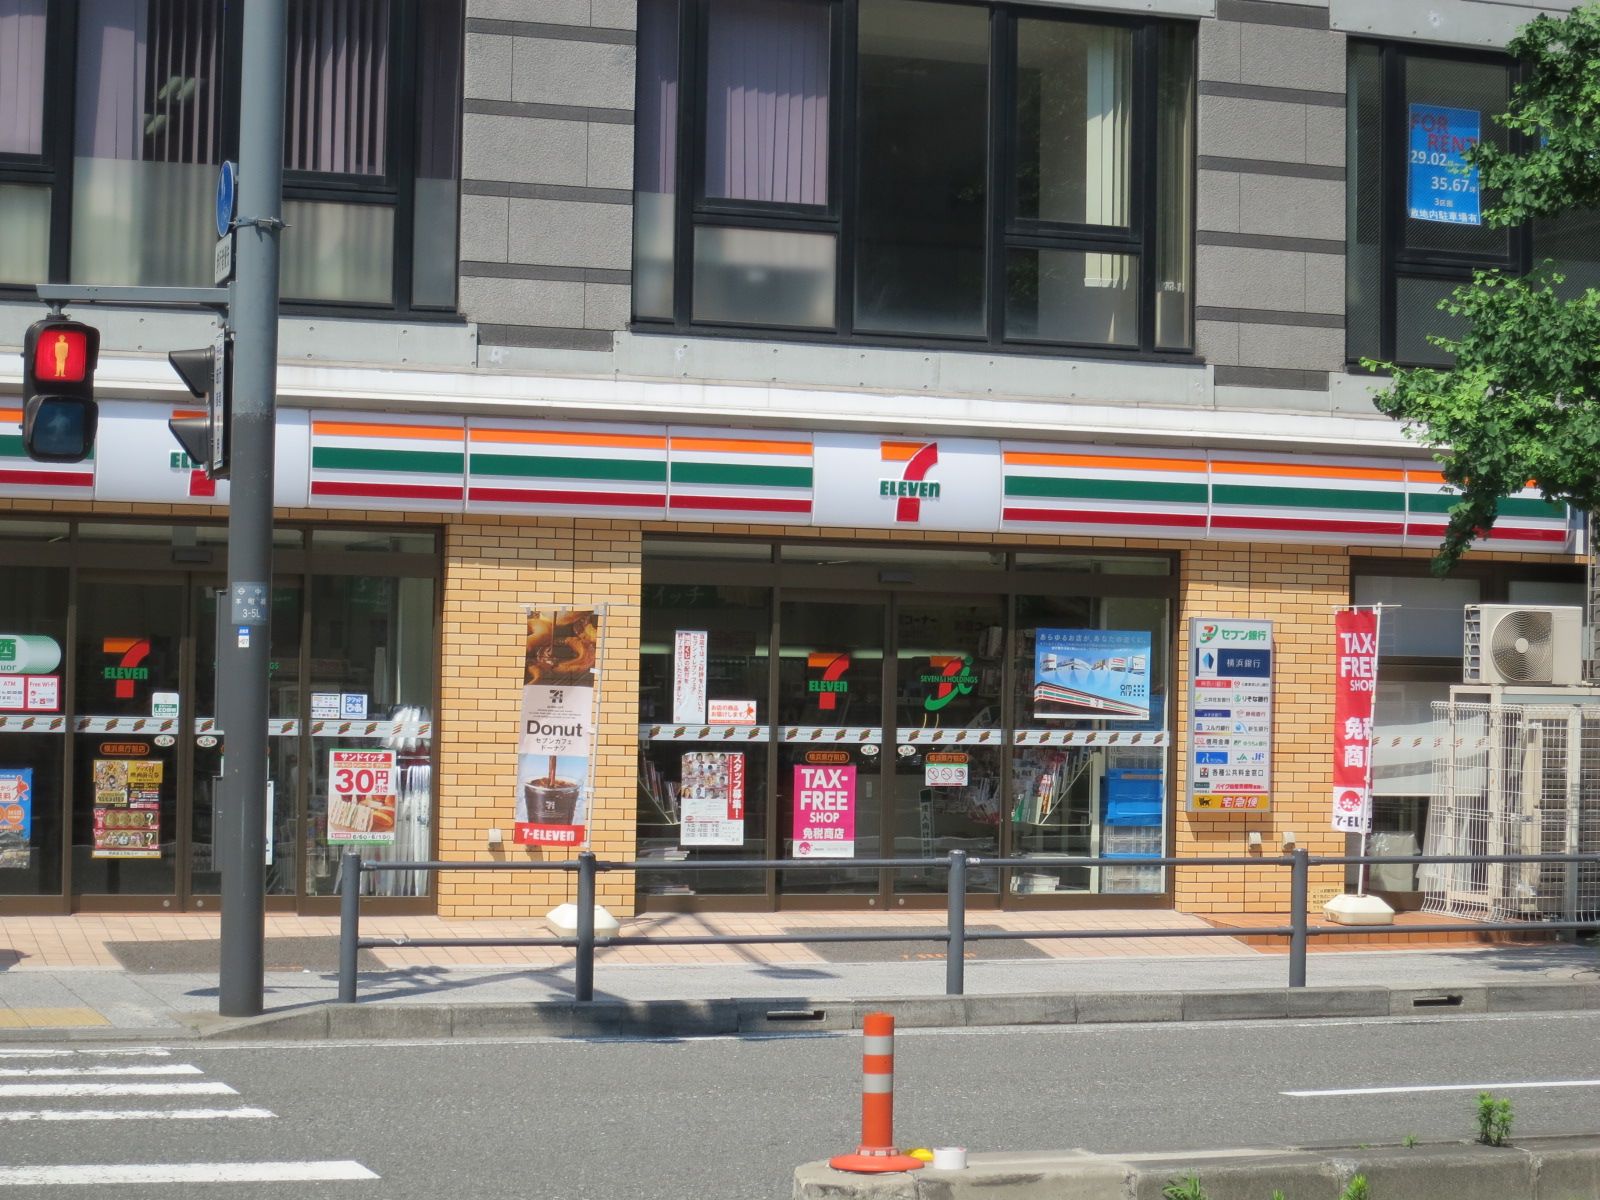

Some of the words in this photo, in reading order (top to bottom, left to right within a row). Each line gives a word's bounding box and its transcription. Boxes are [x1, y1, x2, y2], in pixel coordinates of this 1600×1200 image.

[1410, 112, 1448, 131] FOR
[1221, 629, 1267, 641] セブン銀行
[1226, 658, 1261, 668] 横浜銀行
[526, 720, 583, 737] Donut
[536, 737, 572, 745] セブンカフェ
[340, 753, 385, 761] サンドイッチ
[1344, 744, 1368, 768] 商
[801, 768, 848, 789] TAX-
[1212, 769, 1264, 777] 各種公共料金窓口
[335, 768, 374, 793] 30
[375, 771, 389, 784] 円
[800, 791, 848, 811] FREE
[1222, 796, 1258, 808] 宅急便
[809, 812, 840, 823] SHOP
[802, 827, 844, 840] 免税商店
